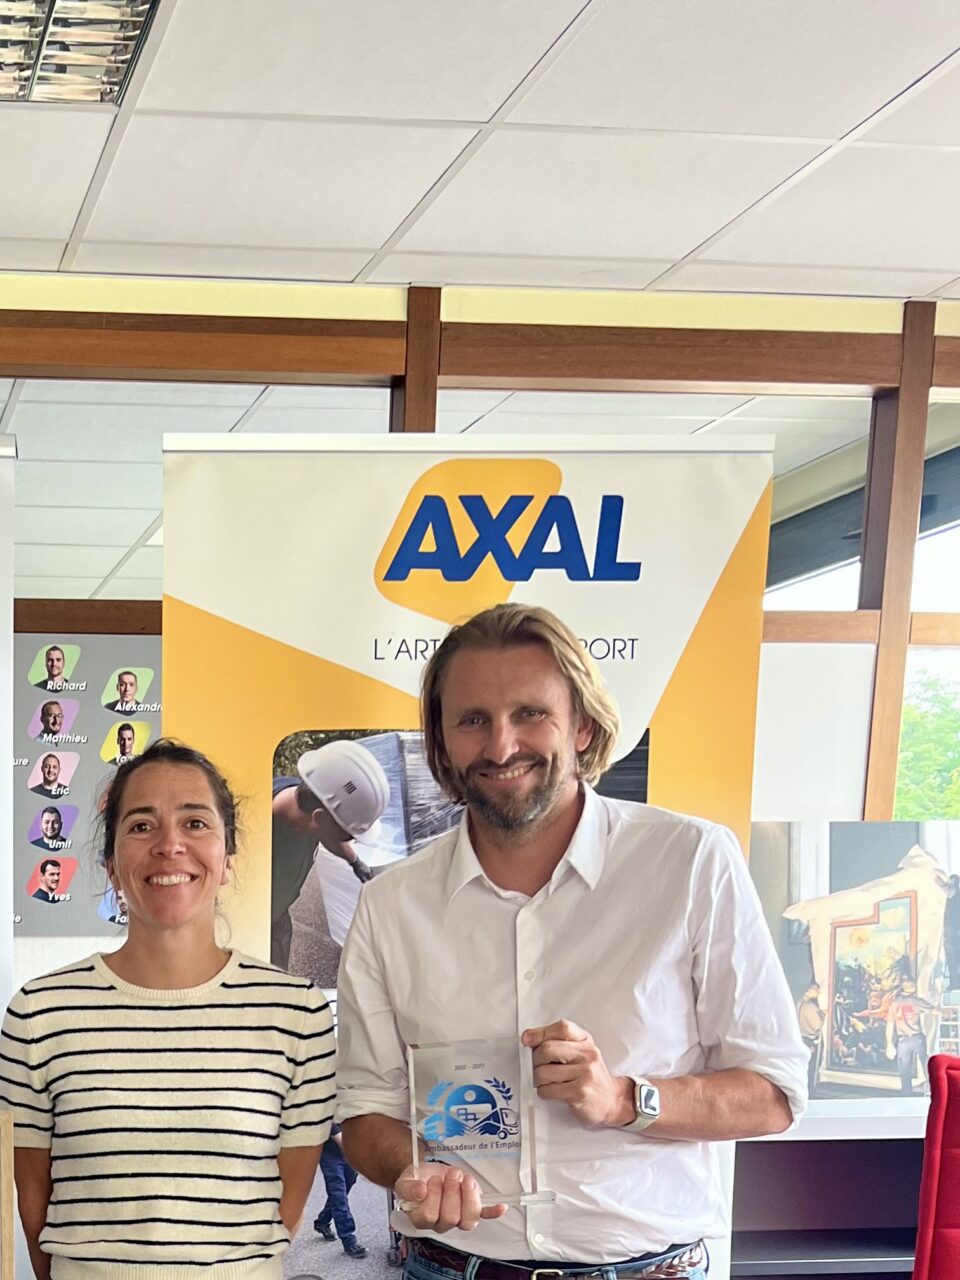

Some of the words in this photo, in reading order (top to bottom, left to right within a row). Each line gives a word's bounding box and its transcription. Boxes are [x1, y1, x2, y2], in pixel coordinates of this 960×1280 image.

[383, 495, 642, 582] AXAL
[46, 681, 87, 691] Richard
[42, 732, 88, 744] Matthieu
[51, 786, 70, 795] Eric
[48, 839, 72, 849] Umit
[48, 892, 71, 901] Yves
[479, 1141, 488, 1150] de
